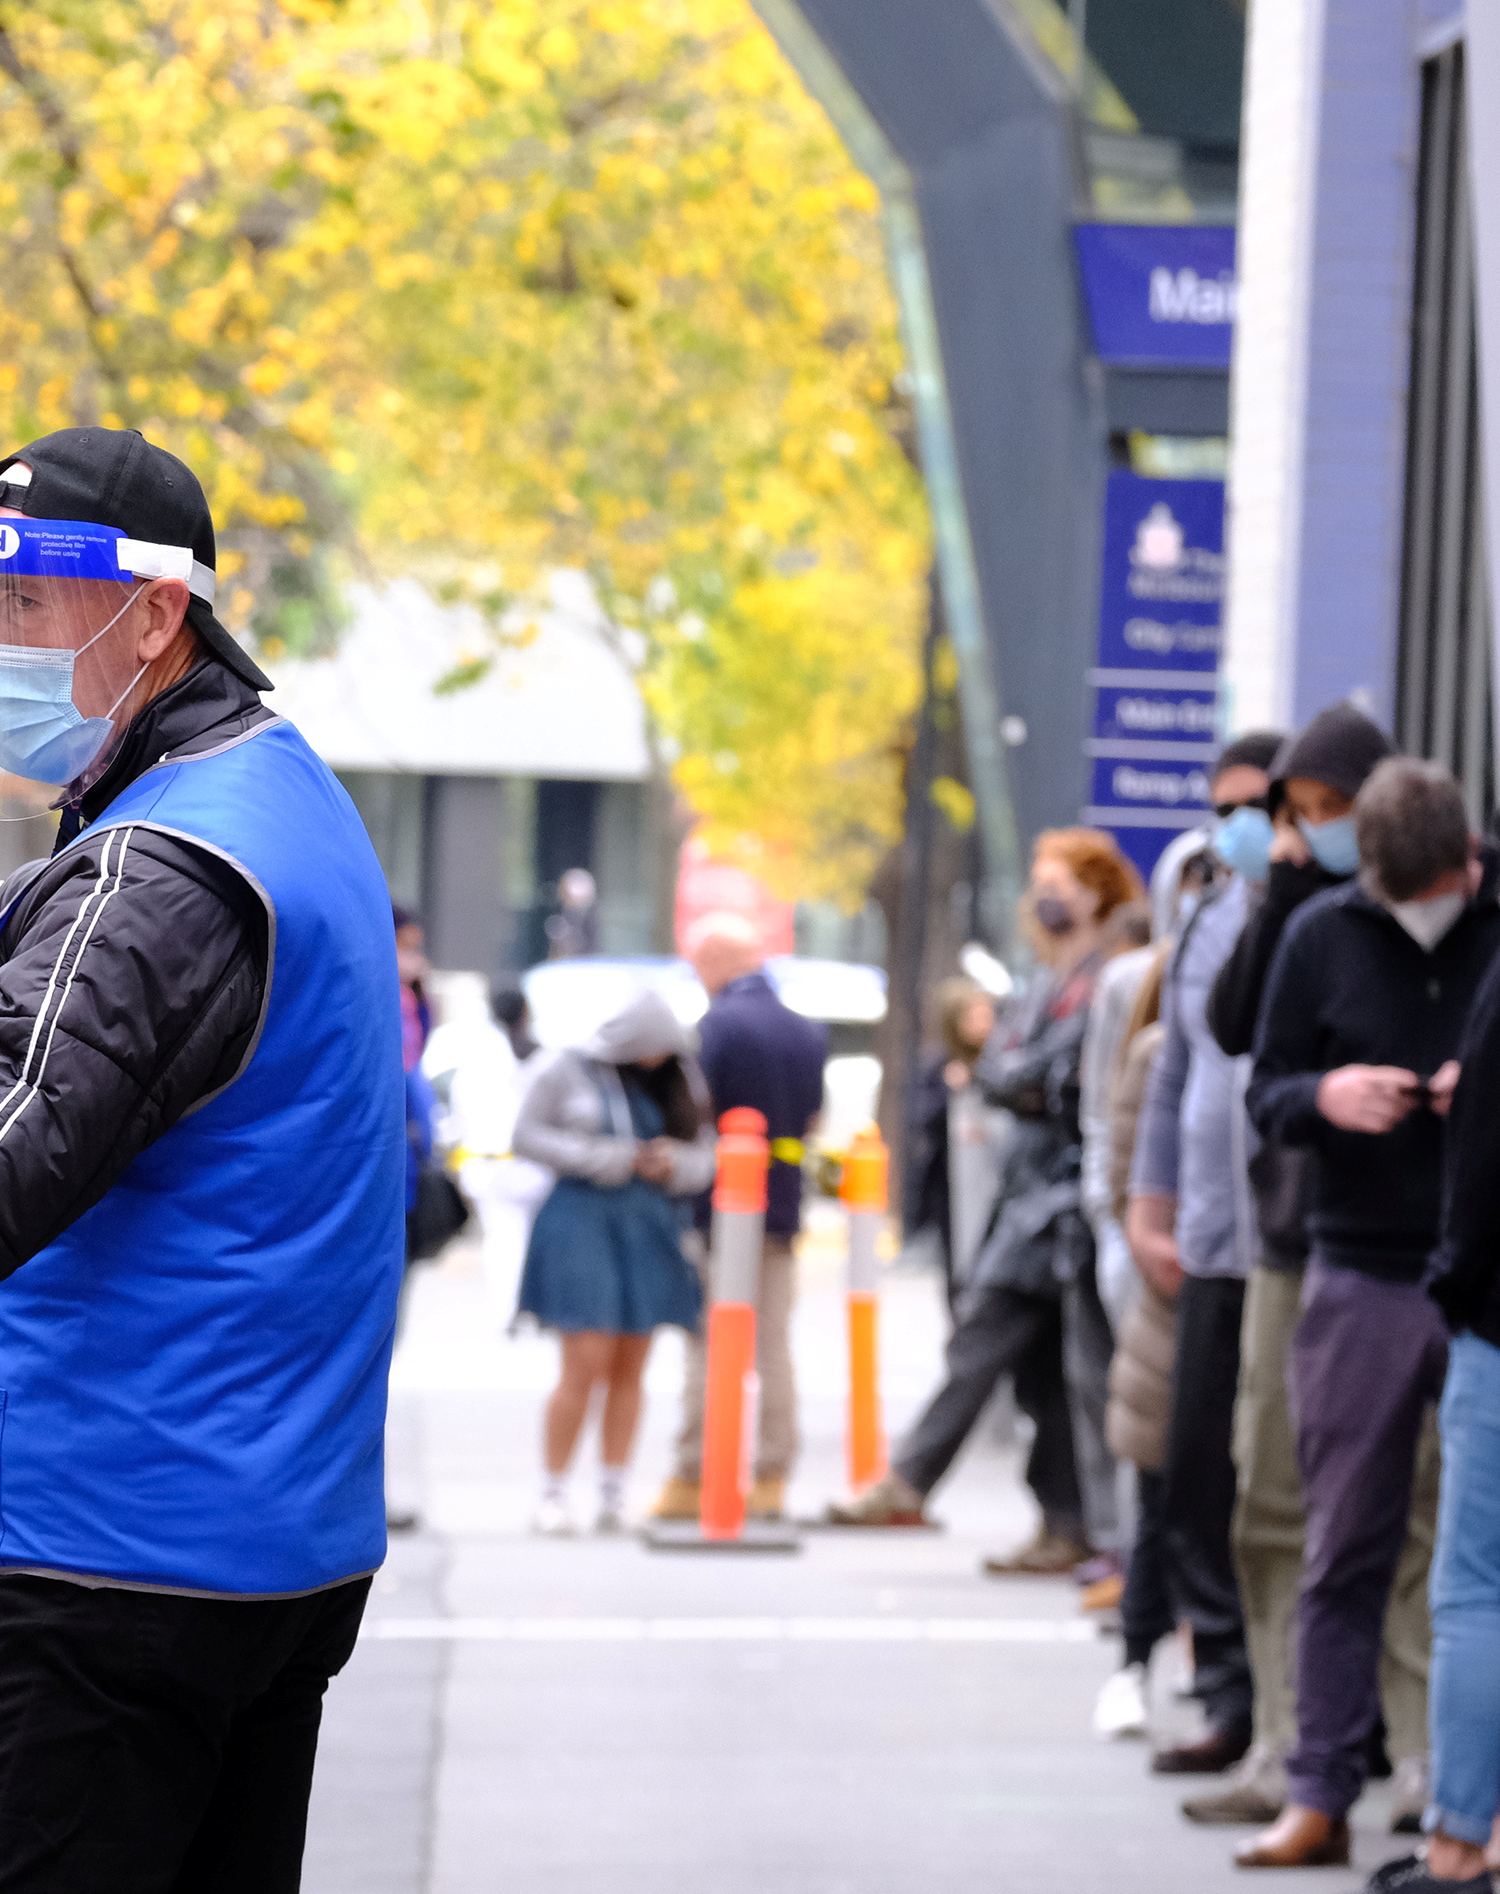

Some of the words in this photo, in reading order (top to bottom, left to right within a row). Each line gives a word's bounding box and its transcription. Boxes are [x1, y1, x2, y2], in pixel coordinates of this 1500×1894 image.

[65, 534, 85, 542] gently
[41, 541, 73, 549] protective
[40, 549, 61, 557] before
[62, 551, 80, 559] using
